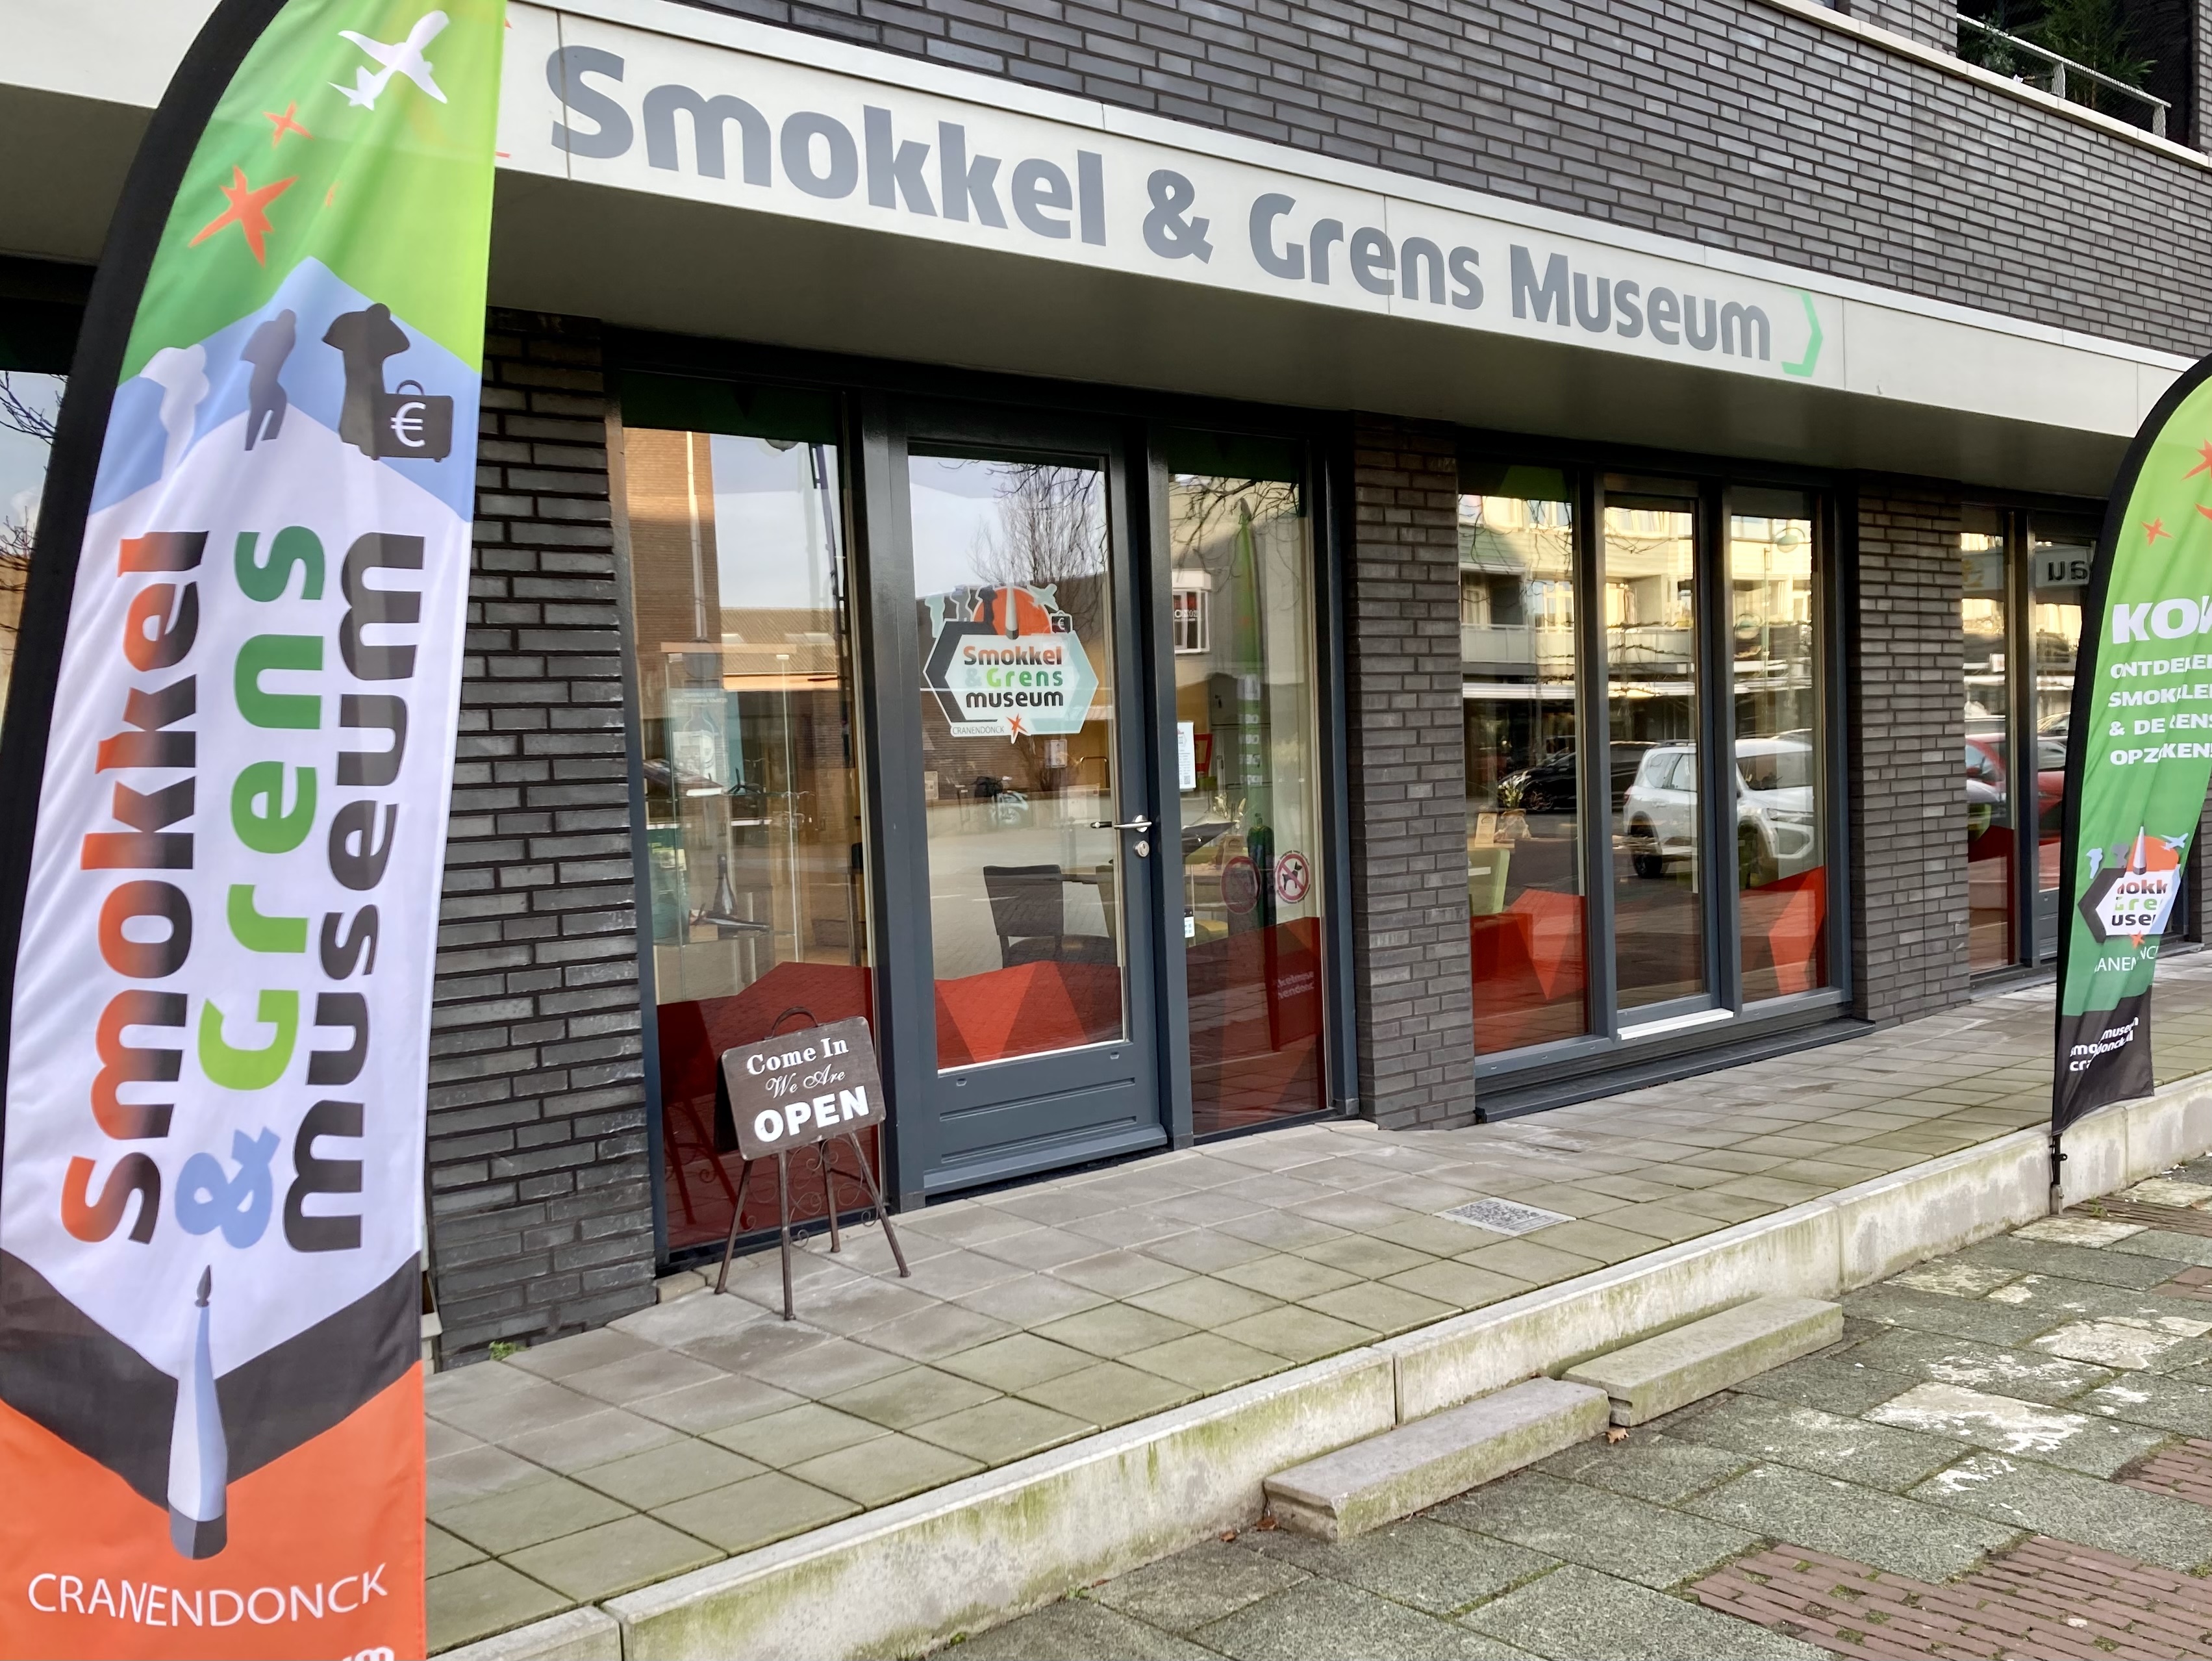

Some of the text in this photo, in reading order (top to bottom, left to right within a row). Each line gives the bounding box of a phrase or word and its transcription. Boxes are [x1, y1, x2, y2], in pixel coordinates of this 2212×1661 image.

[546, 44, 1771, 361] Smokkel & Grens Museum
[963, 646, 1062, 665] Smokkel
[965, 668, 1063, 687] & Grens
[966, 691, 1064, 708] museum
[952, 725, 1005, 735] CRANENDONCK
[2109, 721, 2126, 737] &
[2134, 718, 2166, 735] DE
[60, 530, 210, 1245] Smokkel
[175, 525, 326, 1249] & Grens
[283, 531, 425, 1254] museum
[746, 1037, 849, 1075] Come In
[765, 1063, 846, 1098] We Are
[754, 1085, 870, 1142] OPEN
[27, 1562, 389, 1628] CRANENDONCK
